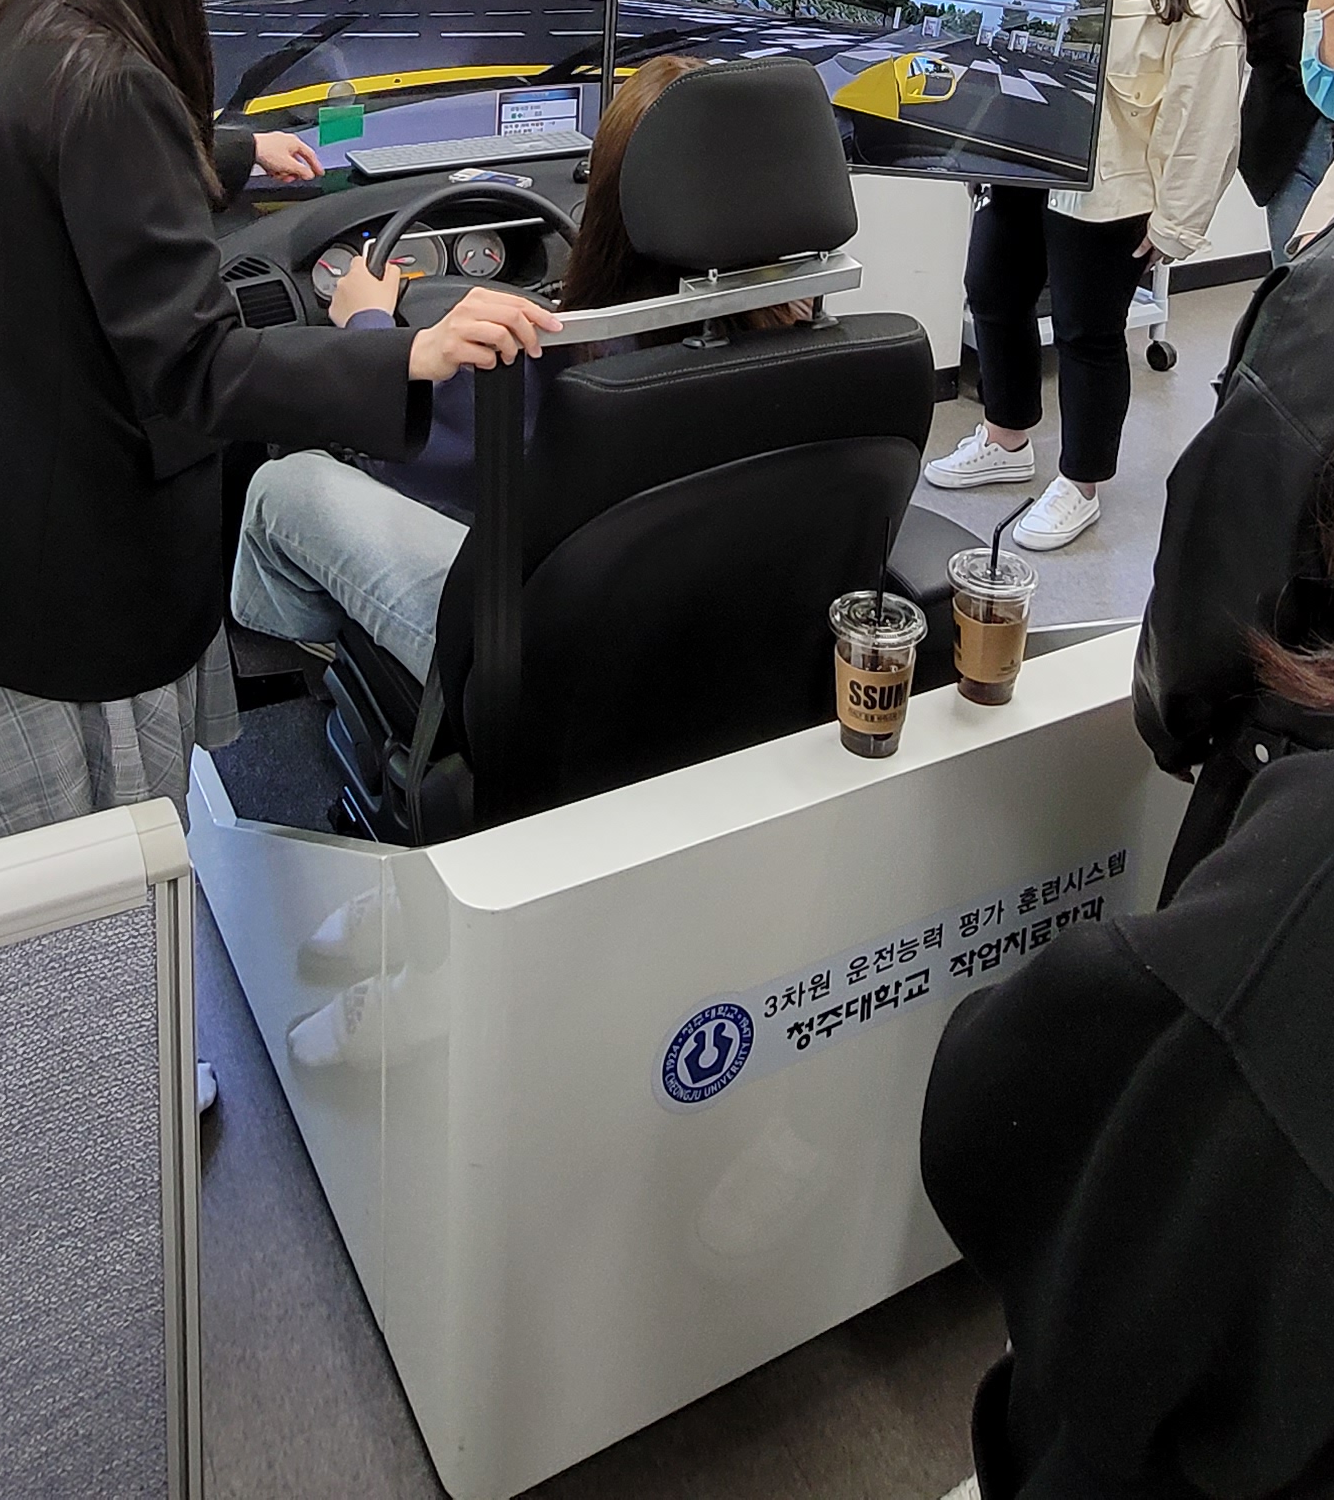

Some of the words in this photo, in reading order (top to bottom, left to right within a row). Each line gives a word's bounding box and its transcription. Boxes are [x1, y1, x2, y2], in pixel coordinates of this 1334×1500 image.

[764, 969, 831, 1018] 3차원
[846, 923, 943, 985] 운전능력
[959, 900, 1004, 938] 평가
[1017, 849, 1126, 915] 훈련시스템
[786, 968, 930, 1050] 청주대학교
[665, 1073, 702, 1100] CHEONGJU
[704, 1043, 750, 1098] UNIVERSITY
[666, 1045, 680, 1071] 1924
